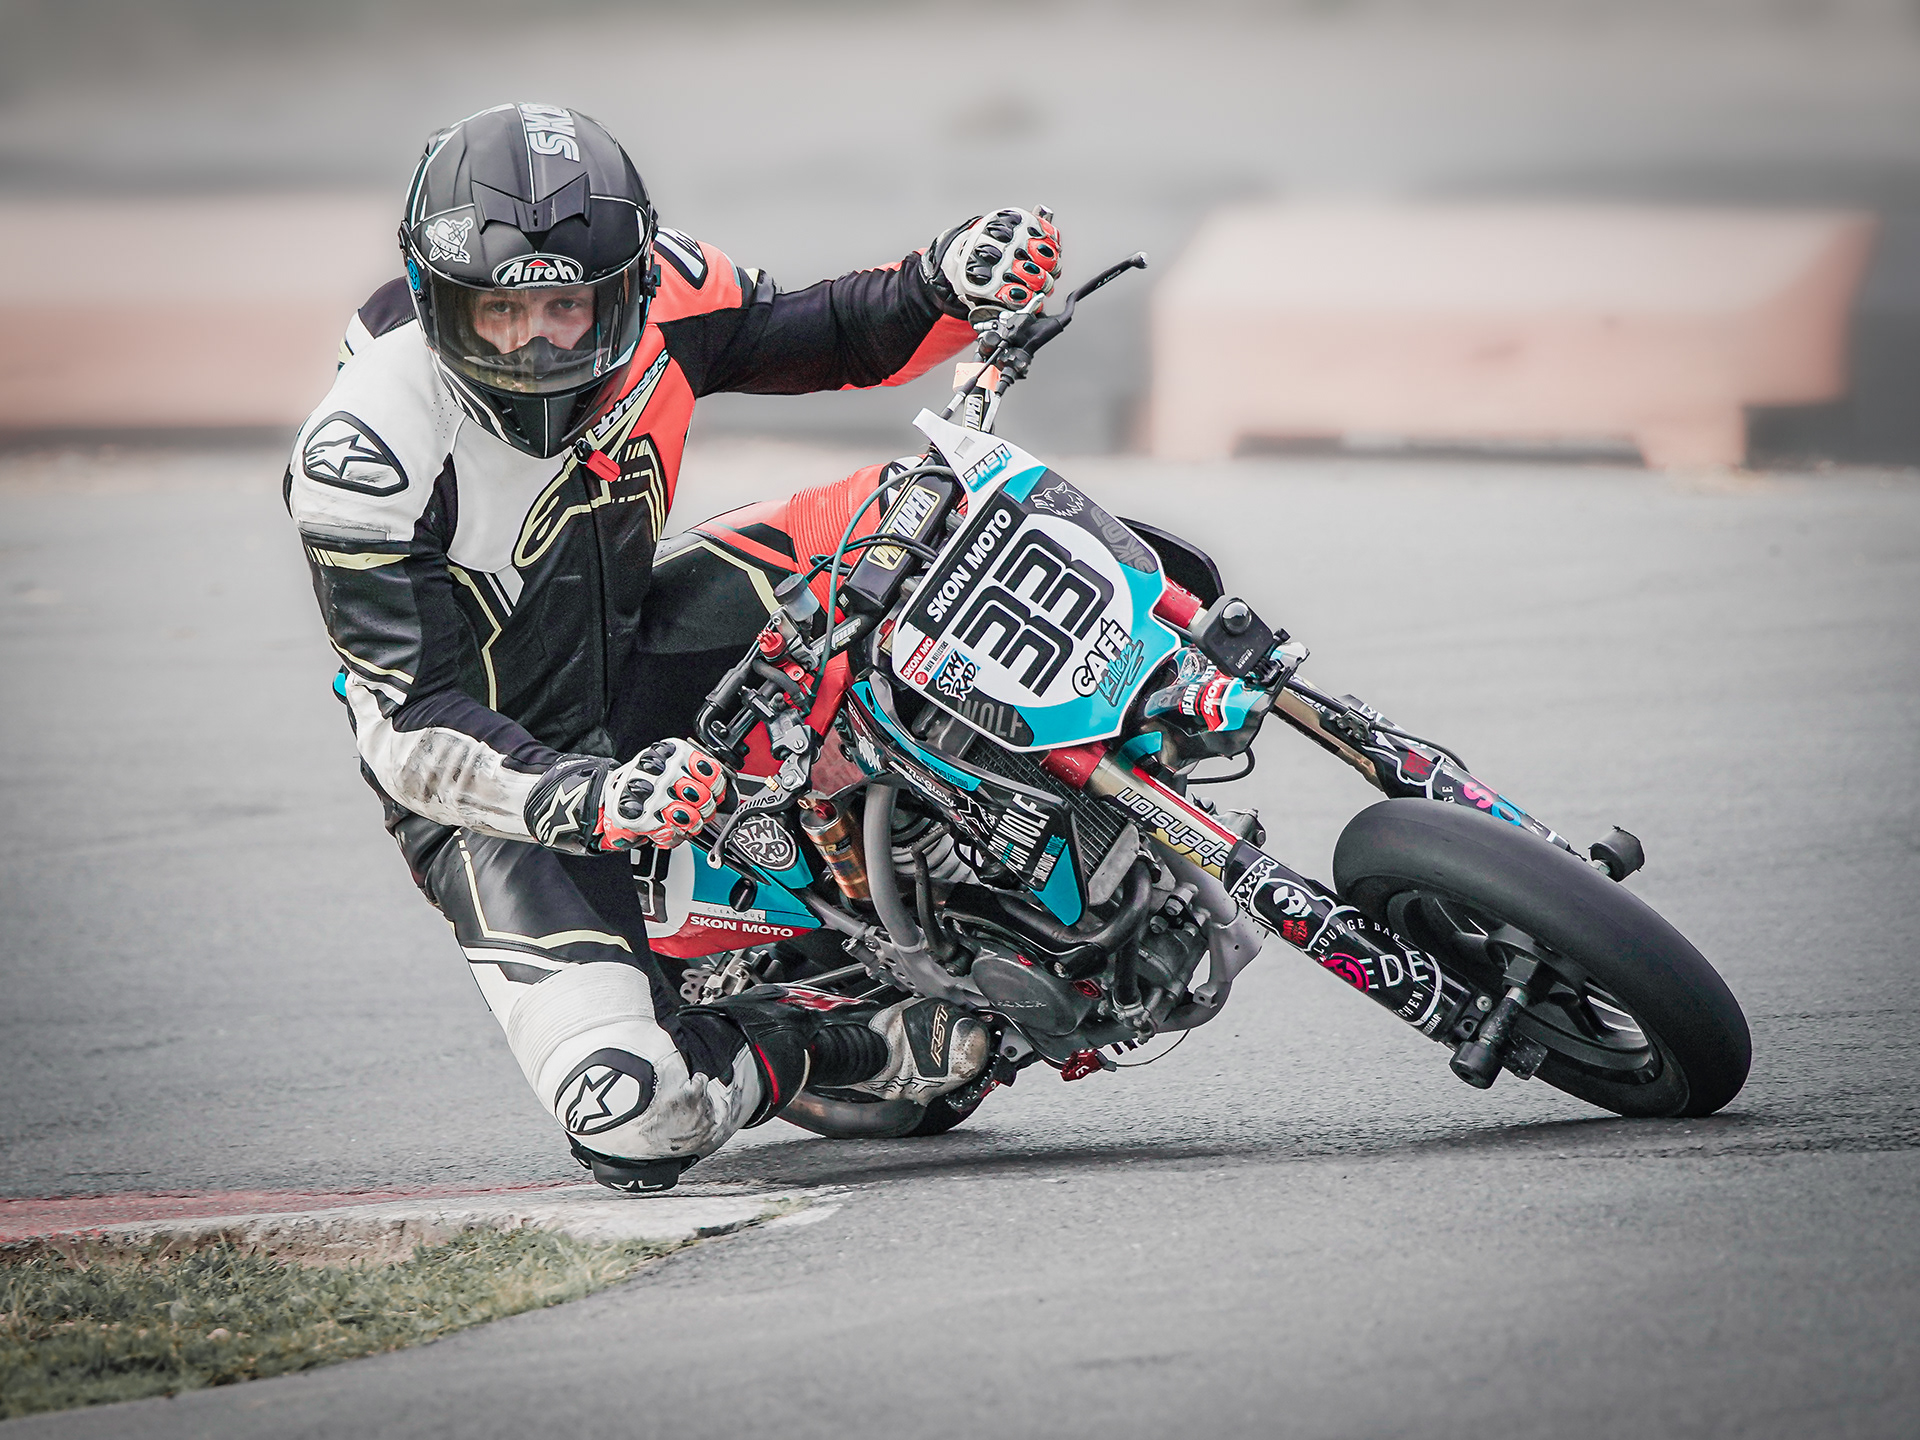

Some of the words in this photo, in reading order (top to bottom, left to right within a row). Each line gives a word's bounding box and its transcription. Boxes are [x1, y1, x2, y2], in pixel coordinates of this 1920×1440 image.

[500, 259, 576, 285] Airoh
[965, 396, 982, 430] TAPER
[927, 567, 972, 622] SKON
[966, 508, 1012, 568] MOTO
[951, 528, 1115, 698] 33
[902, 653, 923, 679] SKON
[937, 649, 966, 694] STAY
[1072, 618, 1133, 697] CAFÉ
[950, 661, 978, 700] RAD
[1181, 683, 1200, 716] DEATH
[734, 819, 777, 845] STAY
[995, 792, 1051, 849] WOLF
[1115, 786, 1229, 868] spension
[742, 840, 788, 862] RAD
[690, 915, 738, 932] SKON
[742, 923, 794, 938] MOTO
[1312, 917, 1366, 955] LOUNGE
[1373, 922, 1402, 942] BAR
[930, 1003, 949, 1068] RST
